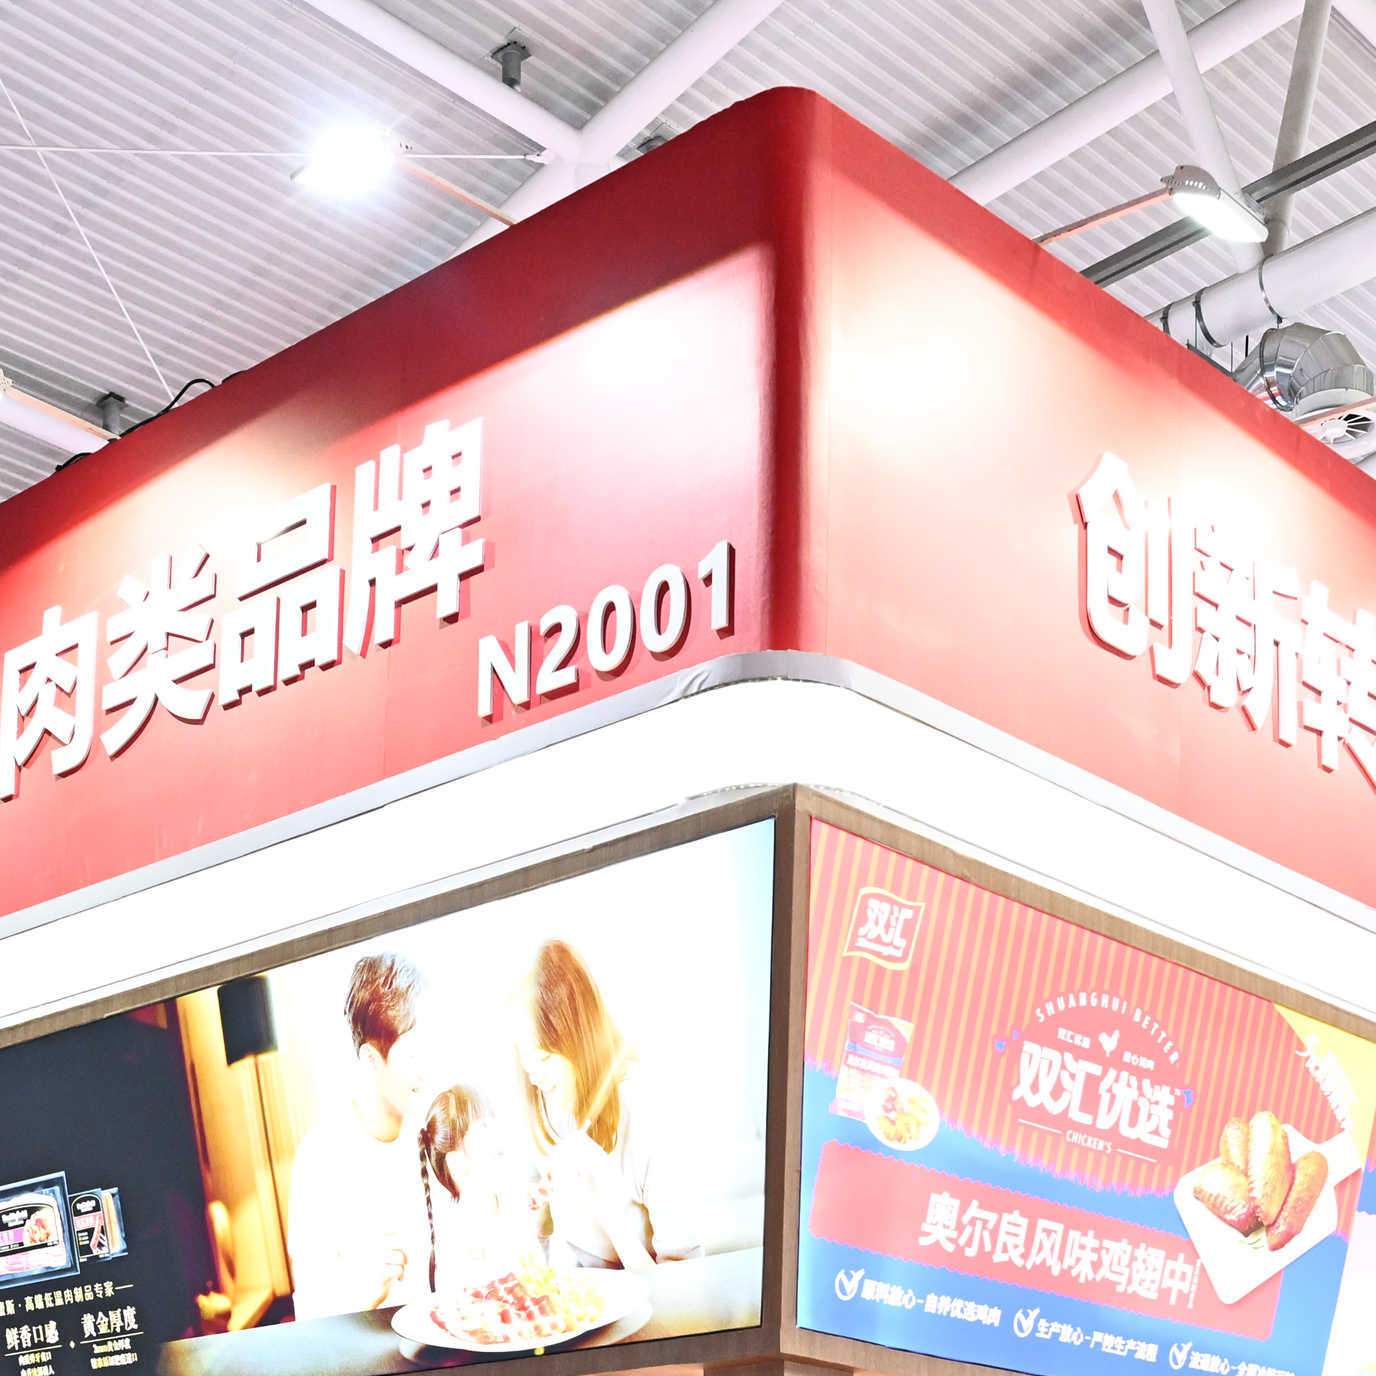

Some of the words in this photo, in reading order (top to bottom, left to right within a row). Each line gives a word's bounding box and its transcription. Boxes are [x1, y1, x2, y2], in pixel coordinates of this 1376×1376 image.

[477, 540, 735, 725] N2001
[858, 898, 914, 946] 双汇
[1036, 992, 1127, 1022] SHUANGHUI
[1133, 1008, 1179, 1064] BETTER
[1012, 1040, 1175, 1149] 双汇优选
[917, 1191, 1194, 1310] 奥尔良风味鸡翅中
